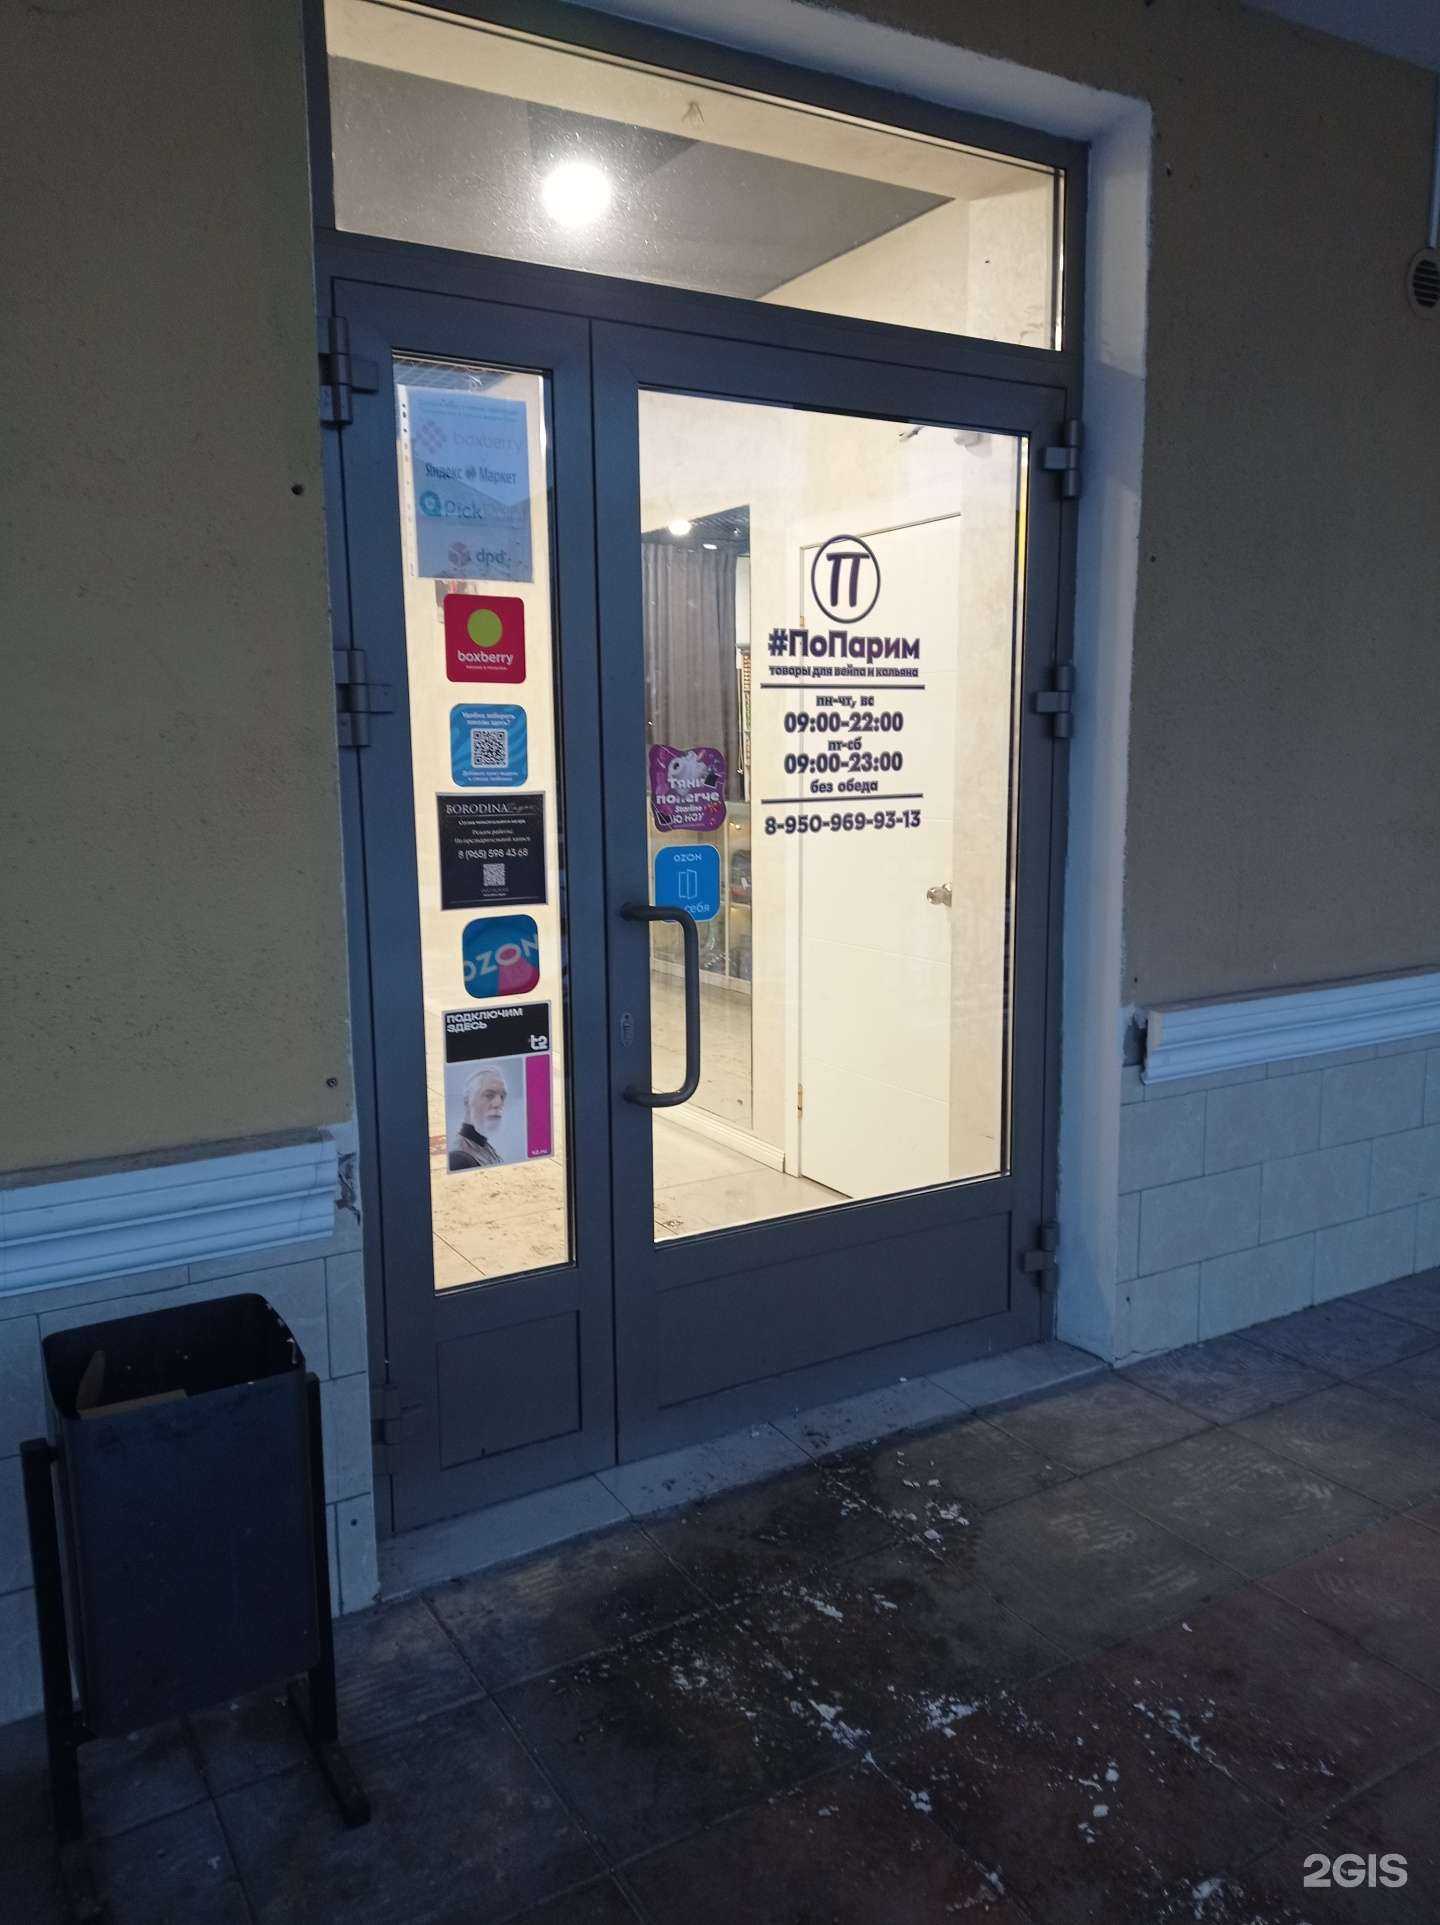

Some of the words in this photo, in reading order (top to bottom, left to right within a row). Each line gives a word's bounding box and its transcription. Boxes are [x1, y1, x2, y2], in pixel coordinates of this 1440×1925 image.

[425, 462, 462, 481] Яндекс
[479, 466, 517, 485] Маркет
[768, 628, 920, 664] #ПоПарим
[457, 650, 514, 666] boxberry
[768, 665, 811, 678] товары
[812, 667, 832, 678] для
[834, 664, 866, 677] вейпа
[867, 667, 875, 677] и
[876, 667, 918, 678] кальяна
[816, 695, 857, 708] пн-чт,
[860, 695, 875, 706] вс
[784, 711, 903, 733] 09:00-22:00
[828, 737, 862, 751] пт-сб
[784, 751, 903, 774] 09:00-23:00
[810, 779, 833, 793] без
[838, 778, 878, 794] обеда
[445, 803, 508, 815] BORODINA
[765, 809, 921, 835] 8-950-969-93-13
